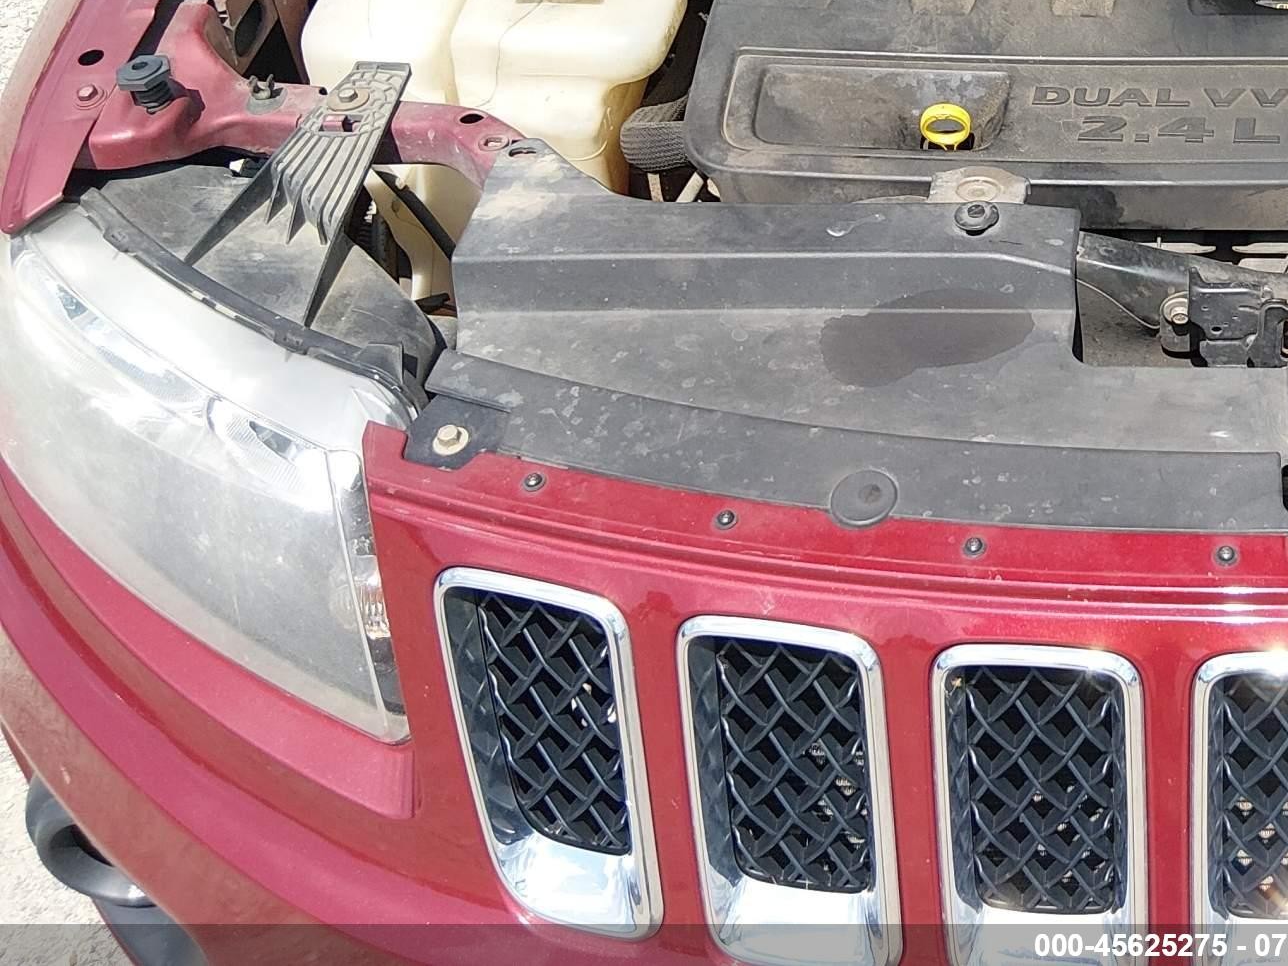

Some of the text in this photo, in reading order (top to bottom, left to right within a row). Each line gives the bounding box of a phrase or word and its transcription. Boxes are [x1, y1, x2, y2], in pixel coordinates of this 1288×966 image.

[1031, 86, 1191, 108] DUAL
[1077, 115, 1281, 144] 2.4 L
